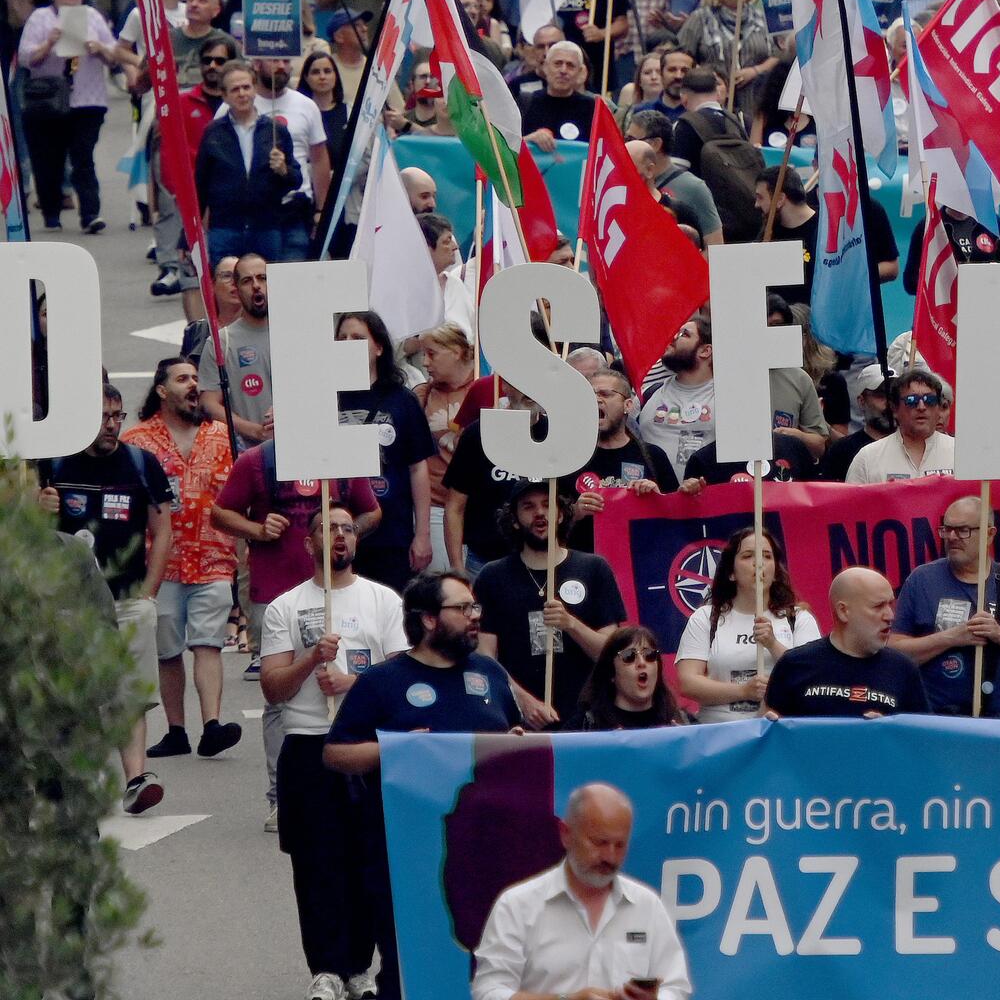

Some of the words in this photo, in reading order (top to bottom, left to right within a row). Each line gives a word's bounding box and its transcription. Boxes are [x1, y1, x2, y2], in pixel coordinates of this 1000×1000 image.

[250, 18, 294, 32] MILITAR
[252, 2, 292, 15] DESFILE
[666, 787, 729, 834] nin
[744, 797, 908, 845] guerra,
[923, 784, 991, 830] nin
[659, 855, 862, 956] PAZ
[895, 855, 957, 955] E
